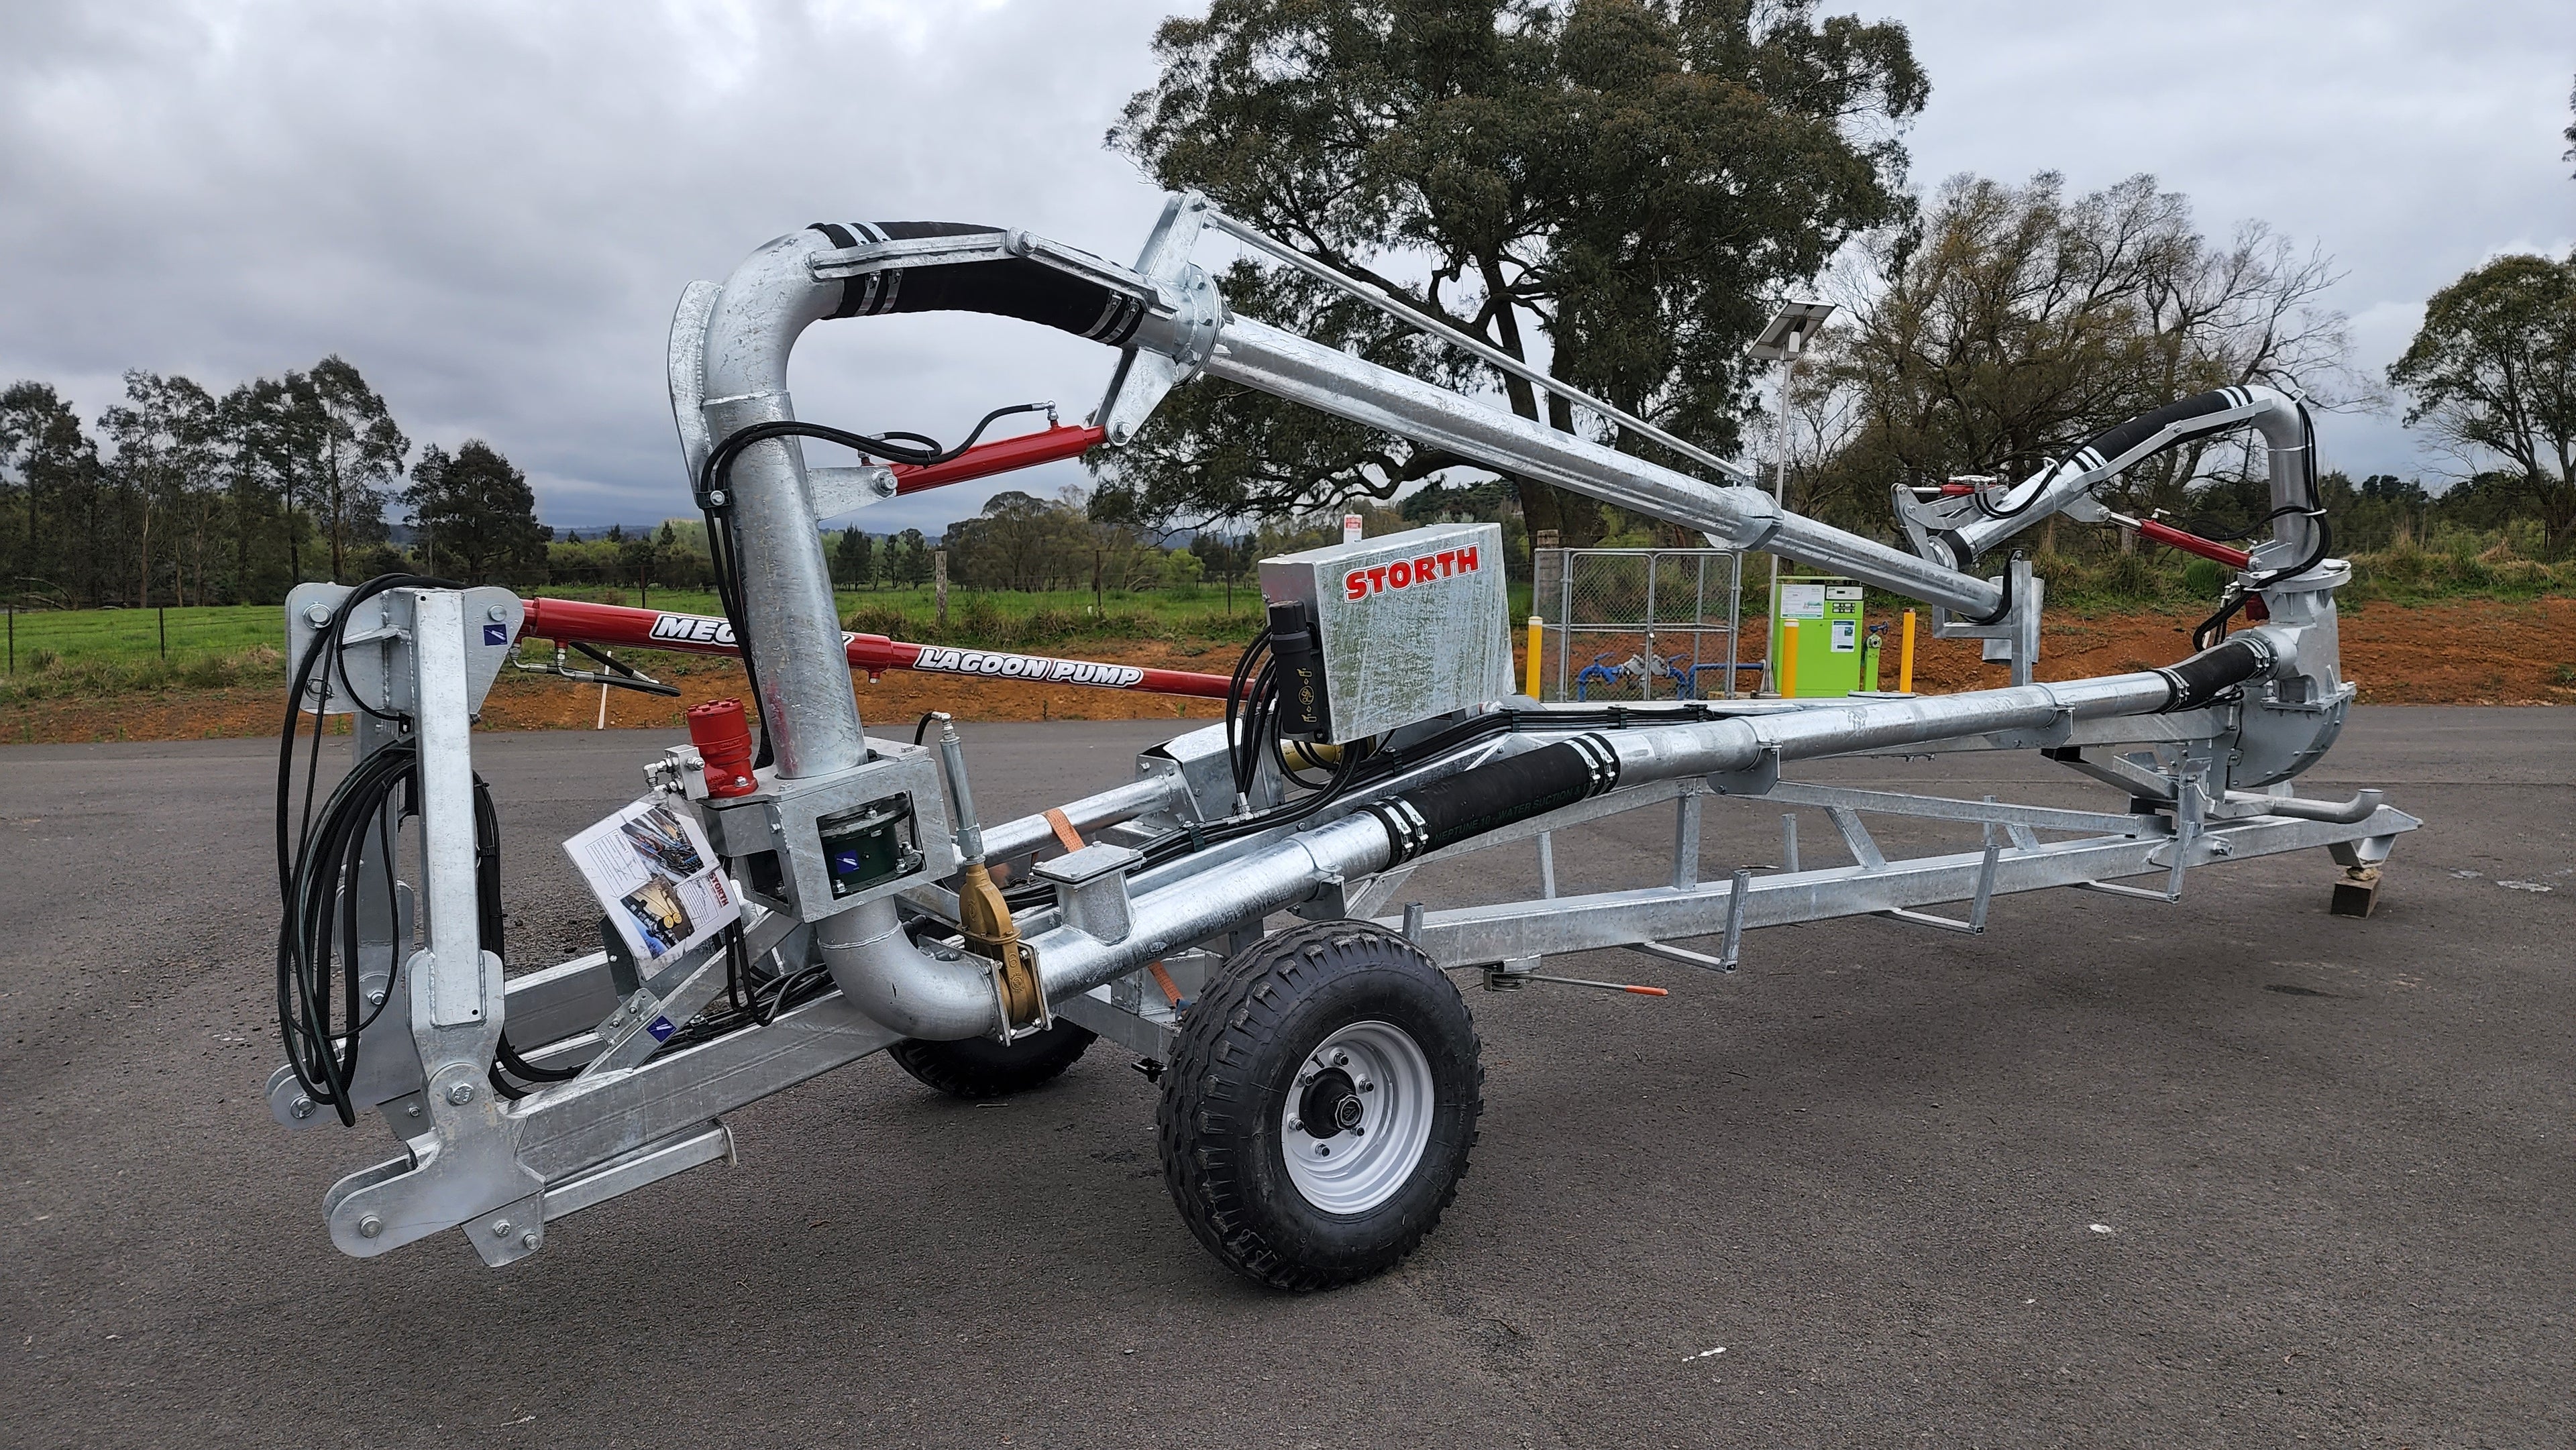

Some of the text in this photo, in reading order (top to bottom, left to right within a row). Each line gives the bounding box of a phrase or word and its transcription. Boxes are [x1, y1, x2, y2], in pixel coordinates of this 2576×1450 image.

[1344, 543, 1481, 601] STORTH
[652, 615, 738, 644] MEG
[916, 648, 1142, 685] LAGOON PUMP
[1435, 820, 1479, 842] NEPTUNE
[1497, 803, 1530, 821] WATER
[1533, 788, 1573, 810] SUCTION
[708, 872, 729, 907] STORTH
